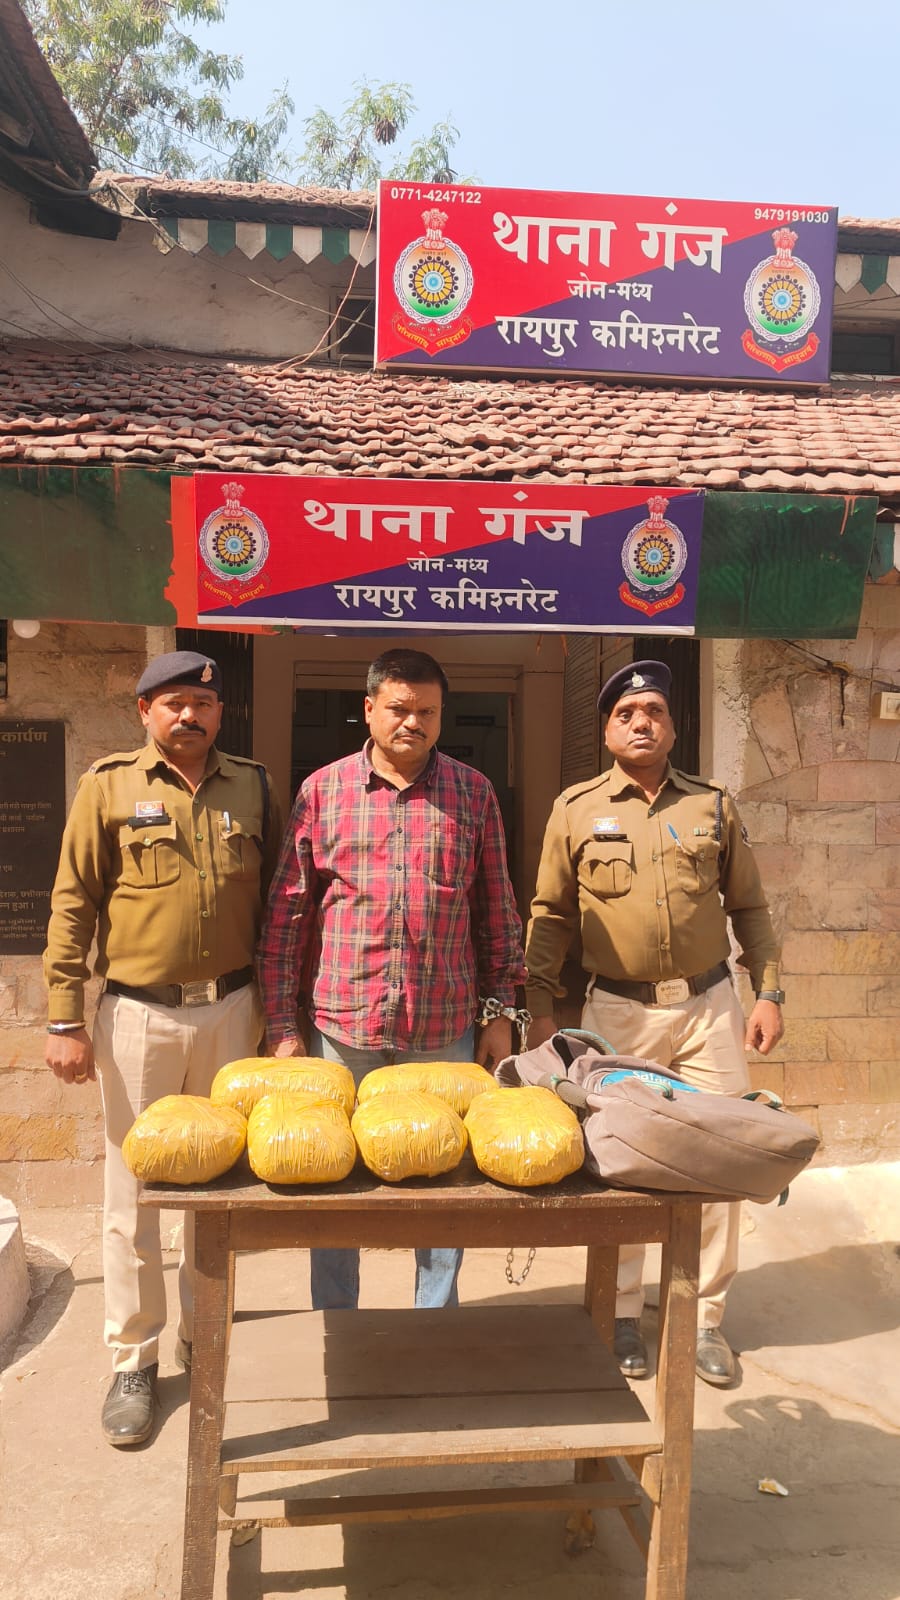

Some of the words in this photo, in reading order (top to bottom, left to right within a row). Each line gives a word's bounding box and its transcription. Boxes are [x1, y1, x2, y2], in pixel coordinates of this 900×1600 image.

[391, 187, 481, 204] 0771-4247122
[754, 207, 829, 224] 9479191030
[493, 211, 617, 267] थाना
[636, 202, 729, 274] गंज
[566, 272, 653, 302] जोन-मध्य
[495, 315, 579, 356] रायपुर
[589, 309, 721, 355] कमिश्नरेट
[303, 499, 455, 544] थाना
[478, 491, 589, 547] गंज
[406, 551, 489, 574] जोन-मध्य
[333, 584, 417, 618] रायपुर
[428, 577, 559, 613] कमिश्नरेट
[0, 727, 48, 743] कार्पण
